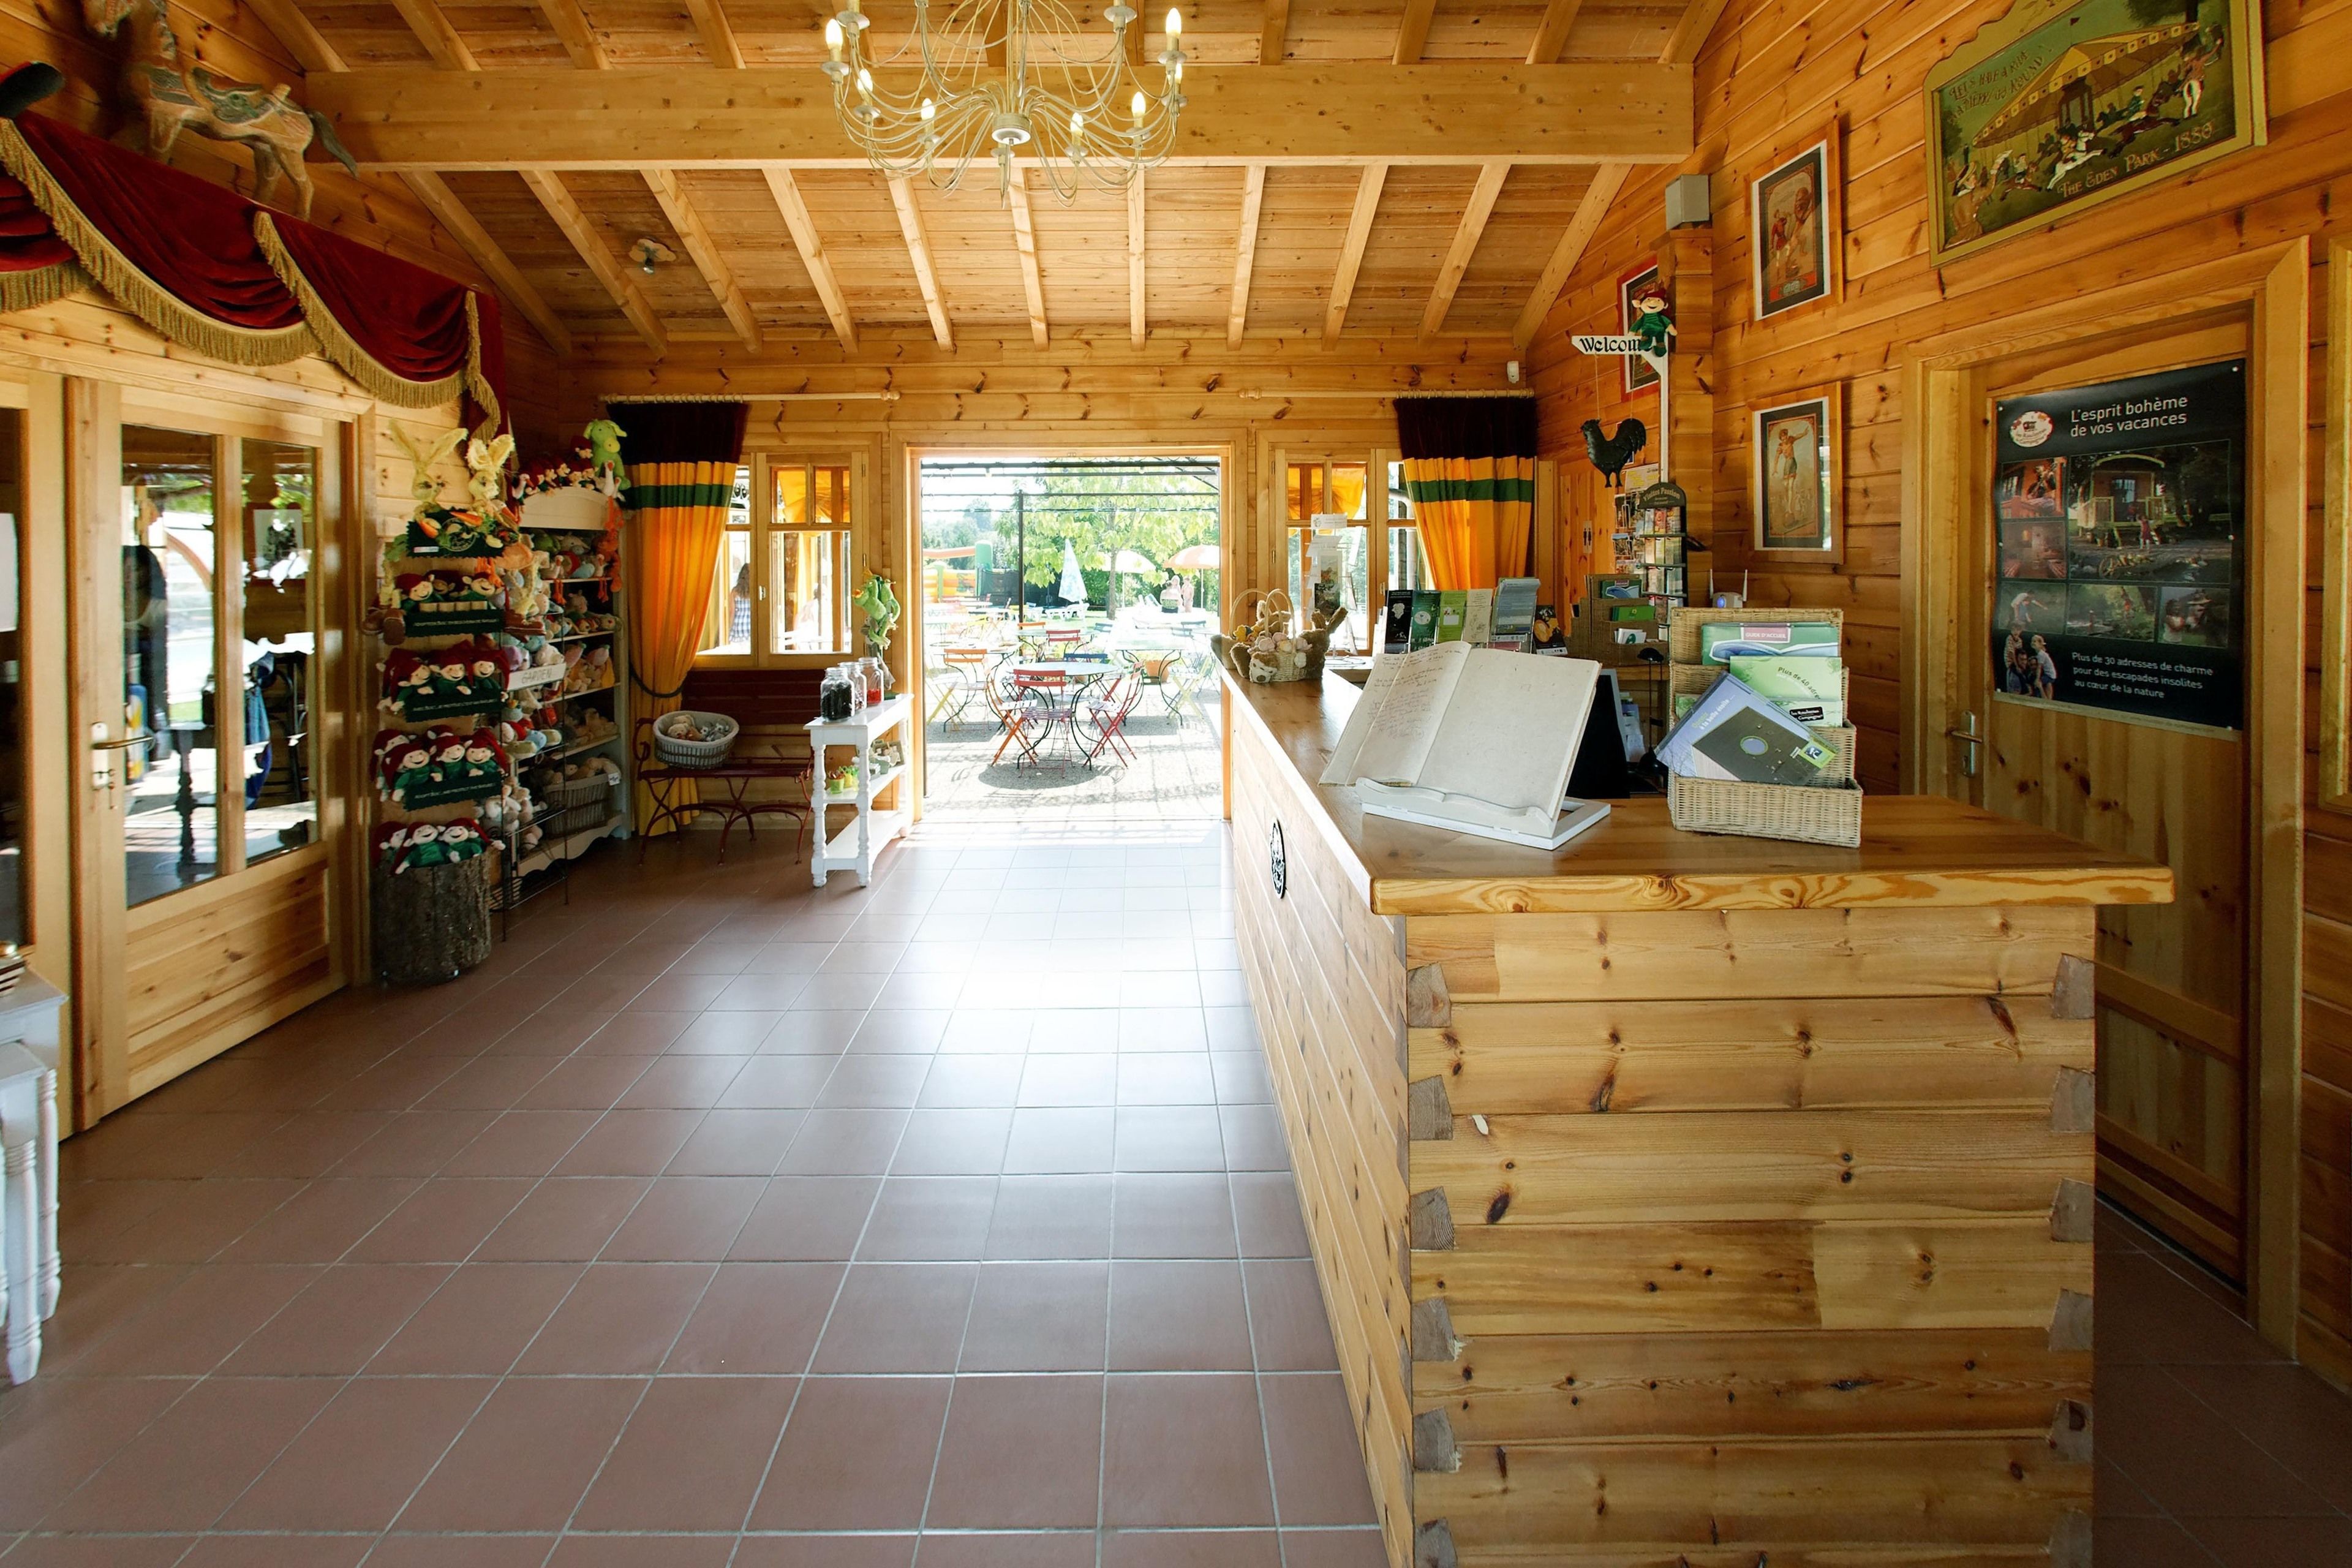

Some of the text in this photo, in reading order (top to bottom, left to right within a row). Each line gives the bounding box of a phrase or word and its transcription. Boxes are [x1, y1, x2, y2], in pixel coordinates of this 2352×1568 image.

[1579, 336, 1653, 352] Welcom
[2071, 396, 2188, 423] L'esprit bohème
[2070, 413, 2187, 437] de vos vacances
[1778, 666, 1792, 676] Plus
[2071, 652, 2214, 676] Plus de 30 adresses de charme
[2073, 665, 2204, 690] pour des escapades insolites
[2110, 682, 2122, 693] de
[2124, 683, 2133, 694] la
[2134, 686, 2166, 699] nature
